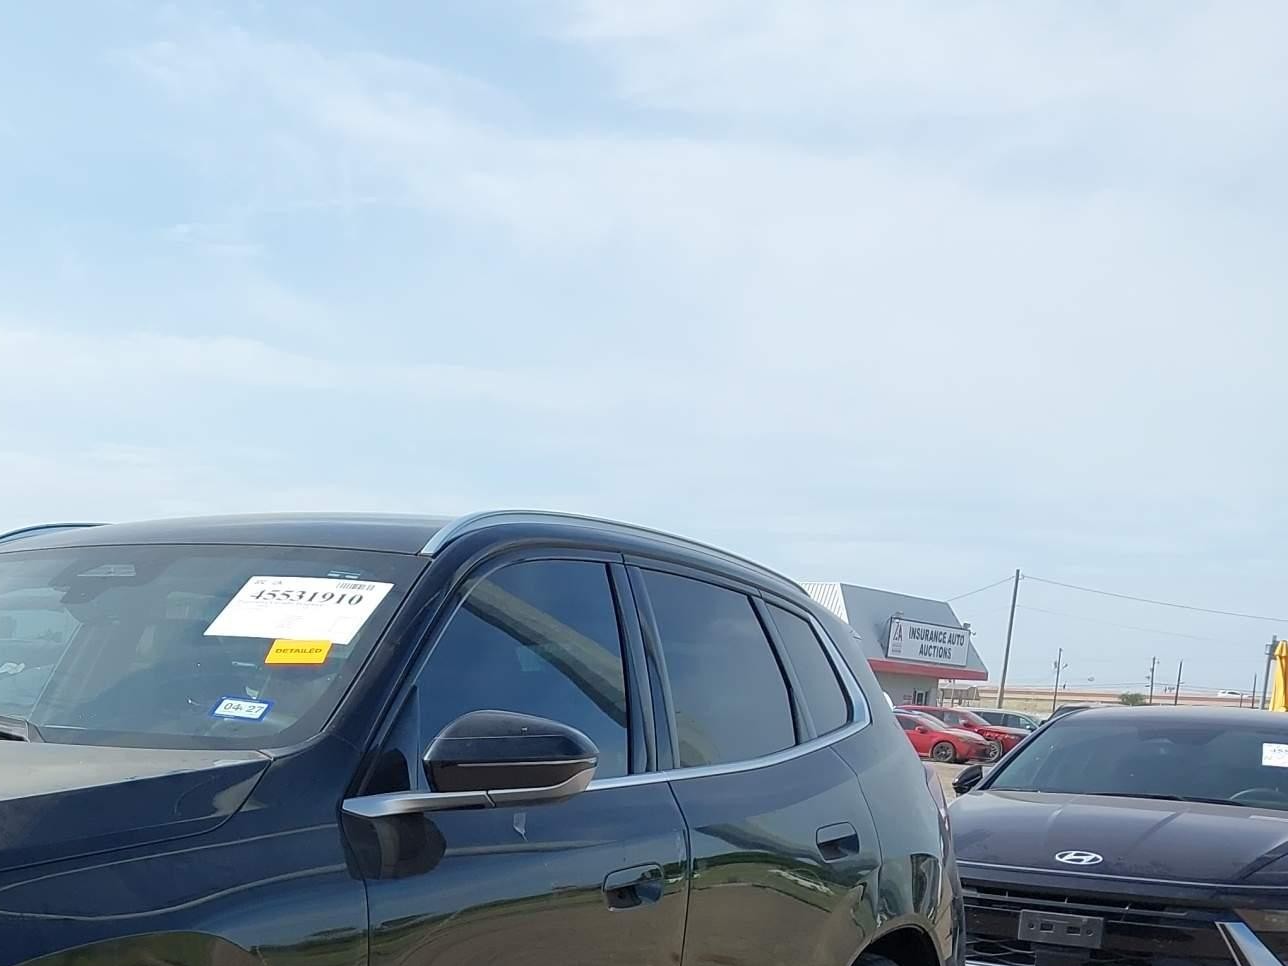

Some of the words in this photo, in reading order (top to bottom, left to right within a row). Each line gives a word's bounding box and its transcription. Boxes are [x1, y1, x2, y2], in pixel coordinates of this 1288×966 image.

[250, 589, 364, 606] 45531910
[908, 627, 947, 644] INSURANCE
[947, 633, 965, 647] AUTO
[919, 644, 952, 659] AUCTIONS
